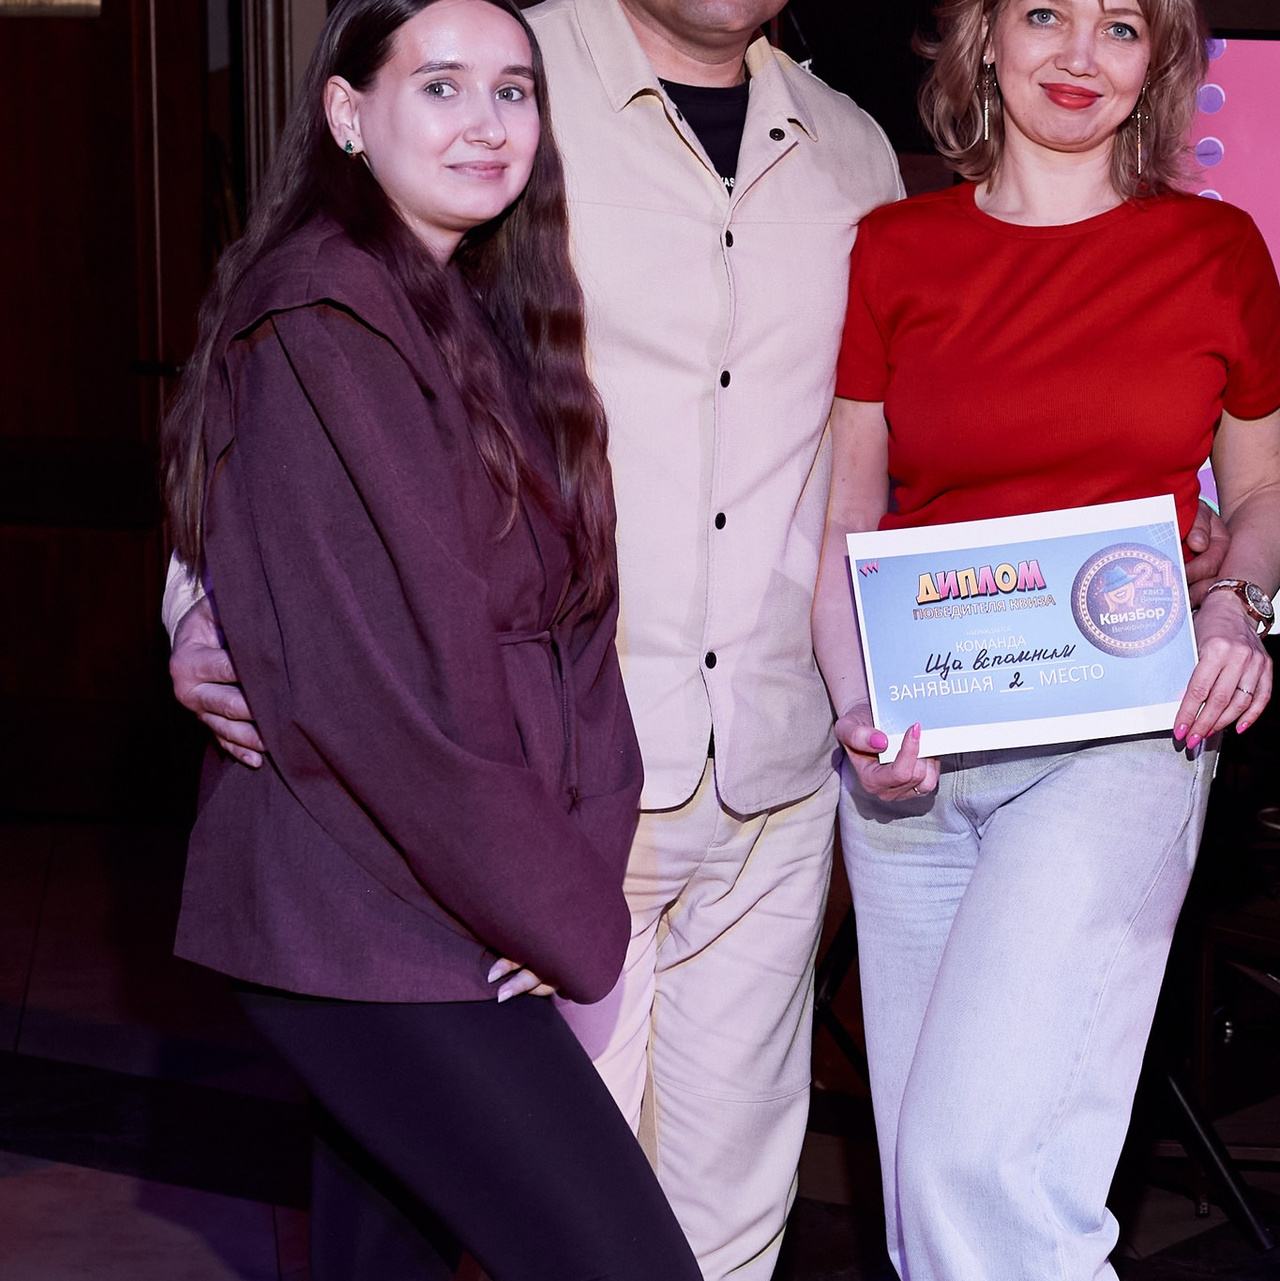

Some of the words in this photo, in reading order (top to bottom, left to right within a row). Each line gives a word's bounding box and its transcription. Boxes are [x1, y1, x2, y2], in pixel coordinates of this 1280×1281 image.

[916, 559, 1047, 605] ДИПЛОМ
[912, 599, 1007, 620] ПОБЕДИТЕЛЯ
[1009, 594, 1057, 611] КВИЗА
[1099, 607, 1166, 626] КвизБор
[955, 634, 1028, 653] КОМАНДА
[925, 651, 964, 681] Ща
[889, 676, 995, 702] ЗАНЯВШАЯ
[1008, 671, 1025, 689] 2
[1039, 663, 1105, 687] МЕСТО
